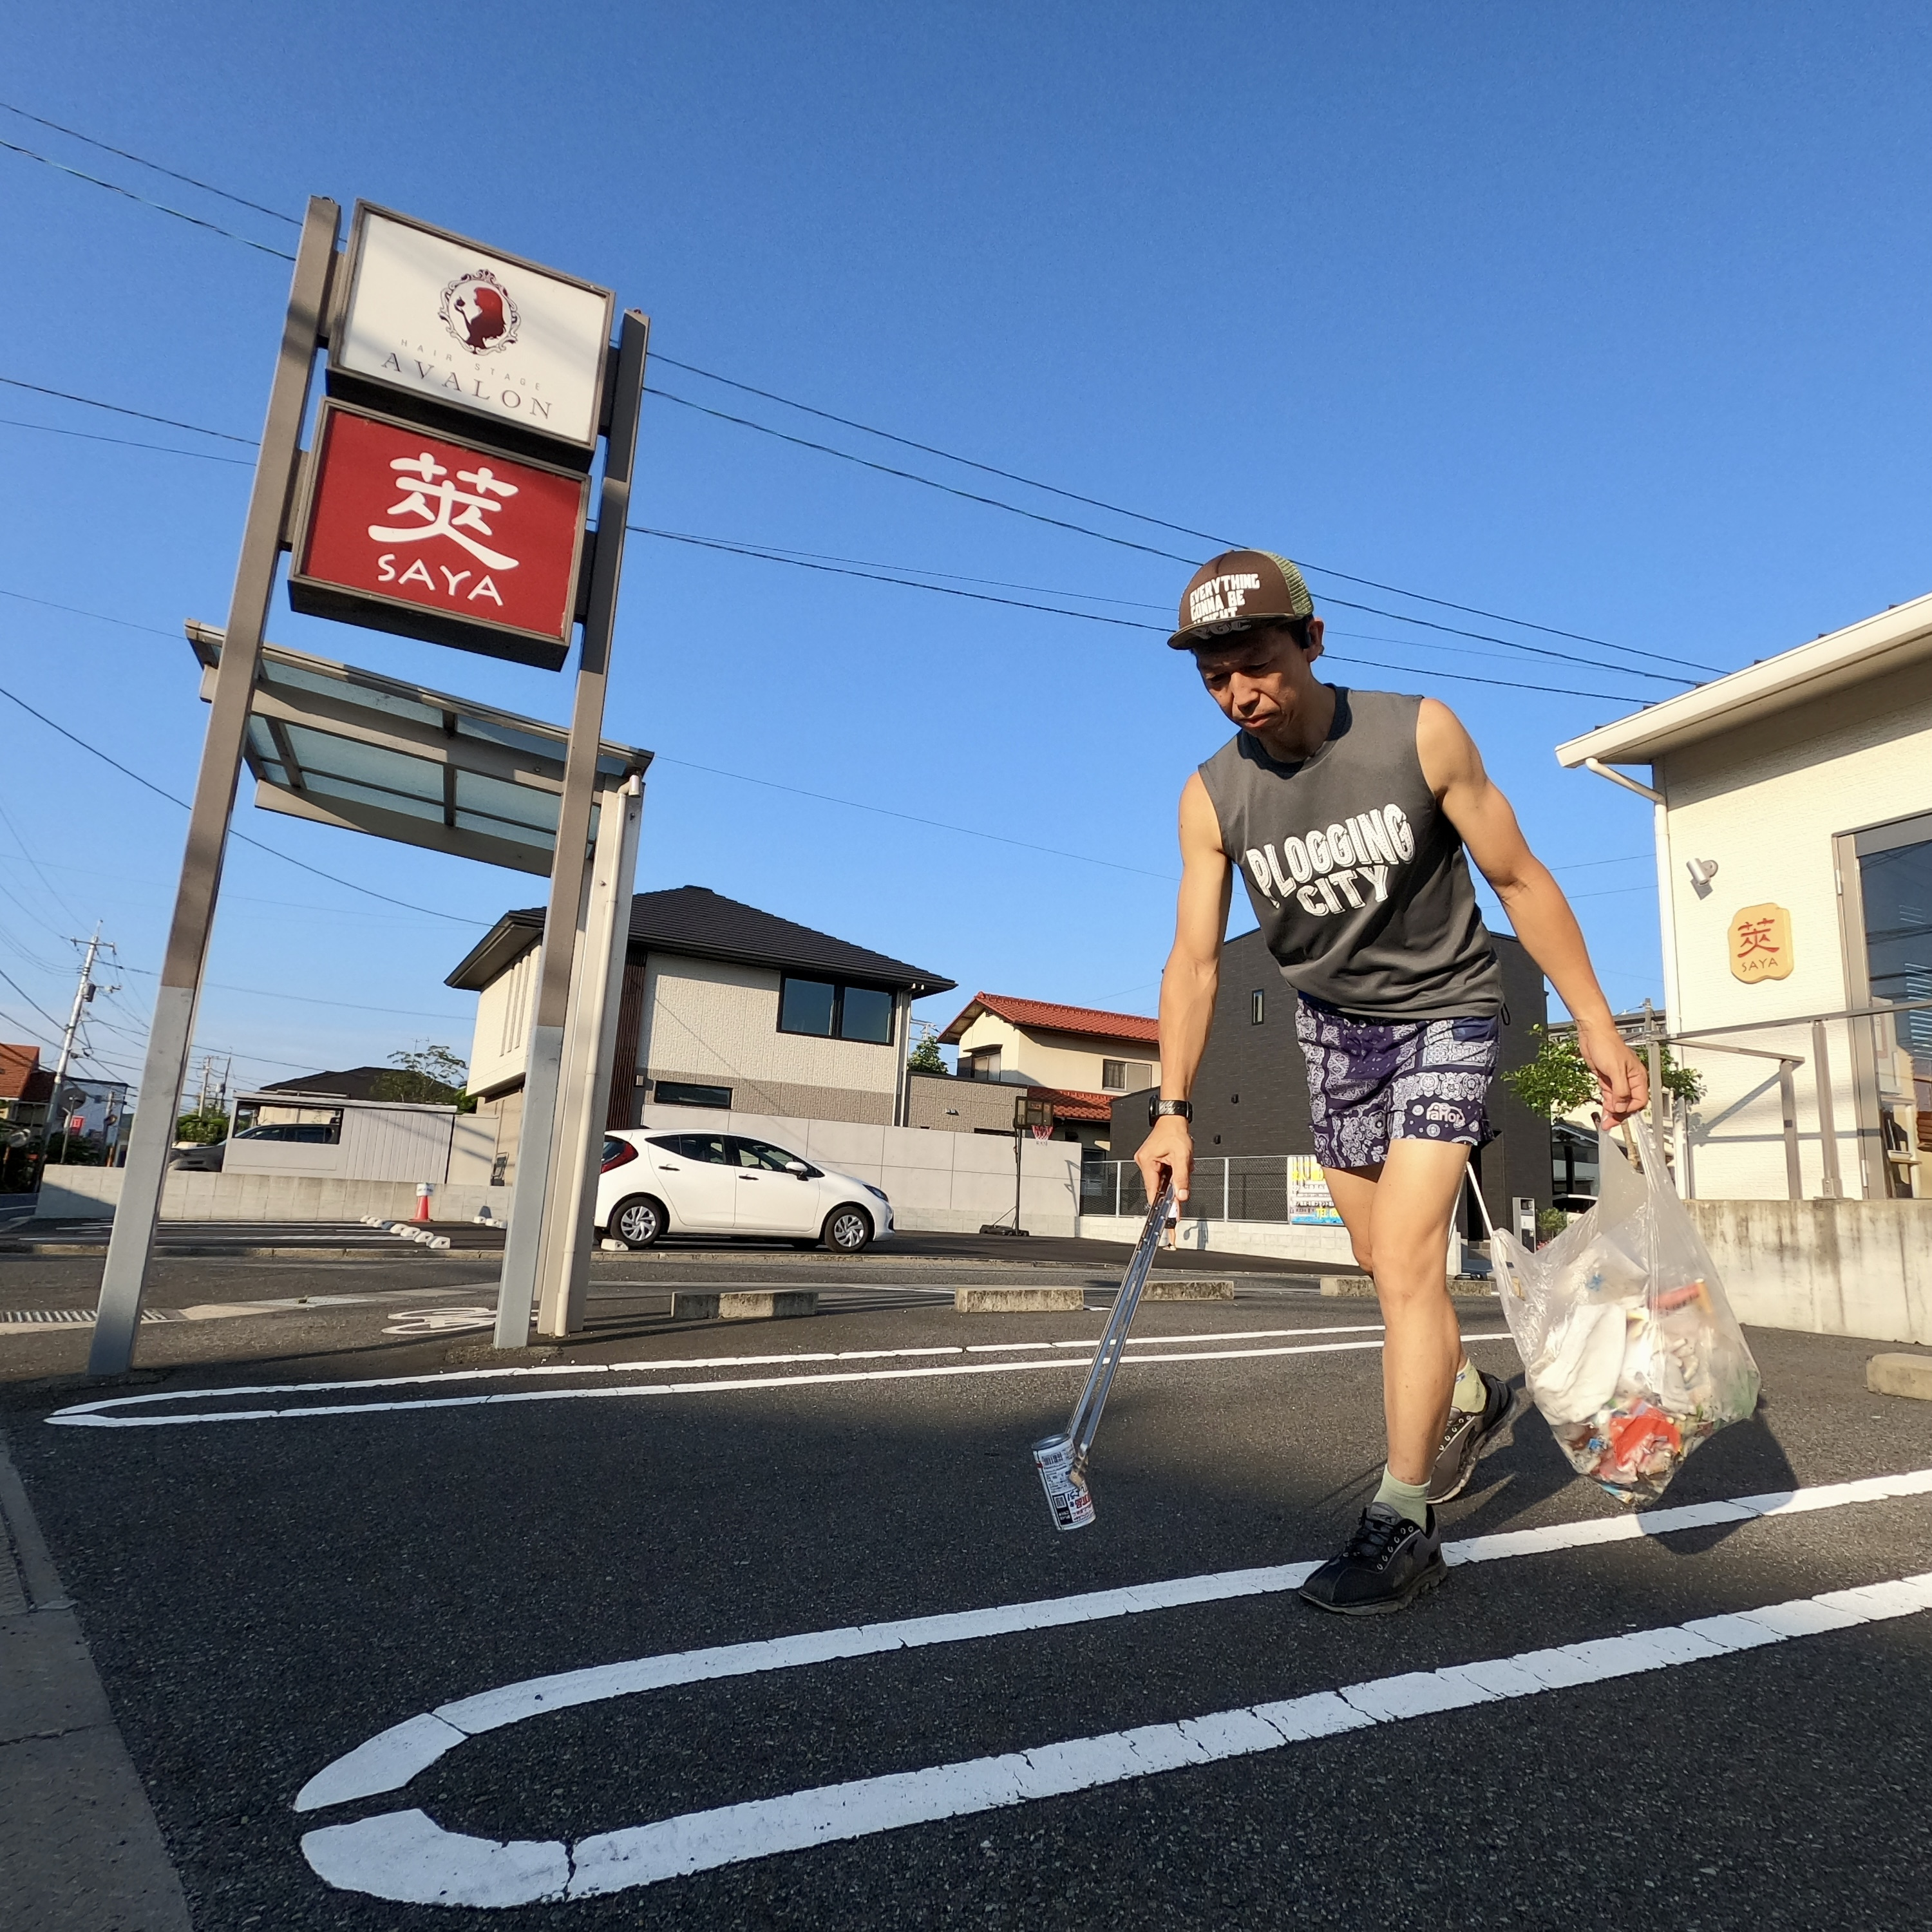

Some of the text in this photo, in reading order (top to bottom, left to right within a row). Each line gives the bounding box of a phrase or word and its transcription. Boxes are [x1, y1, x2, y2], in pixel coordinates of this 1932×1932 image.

[381, 352, 553, 419] AVALON
[401, 339, 541, 390] HAIR STAGE
[368, 452, 520, 571] 莢
[377, 553, 504, 607] SAYA
[1189, 573, 1261, 607] EVERYTHING
[1190, 594, 1225, 622] GONNA
[1227, 589, 1245, 607] BE
[1245, 803, 1416, 909] PLOGGING
[1296, 865, 1389, 917] CITY
[1737, 918, 1780, 958] 莢
[1741, 957, 1779, 973] SAYA
